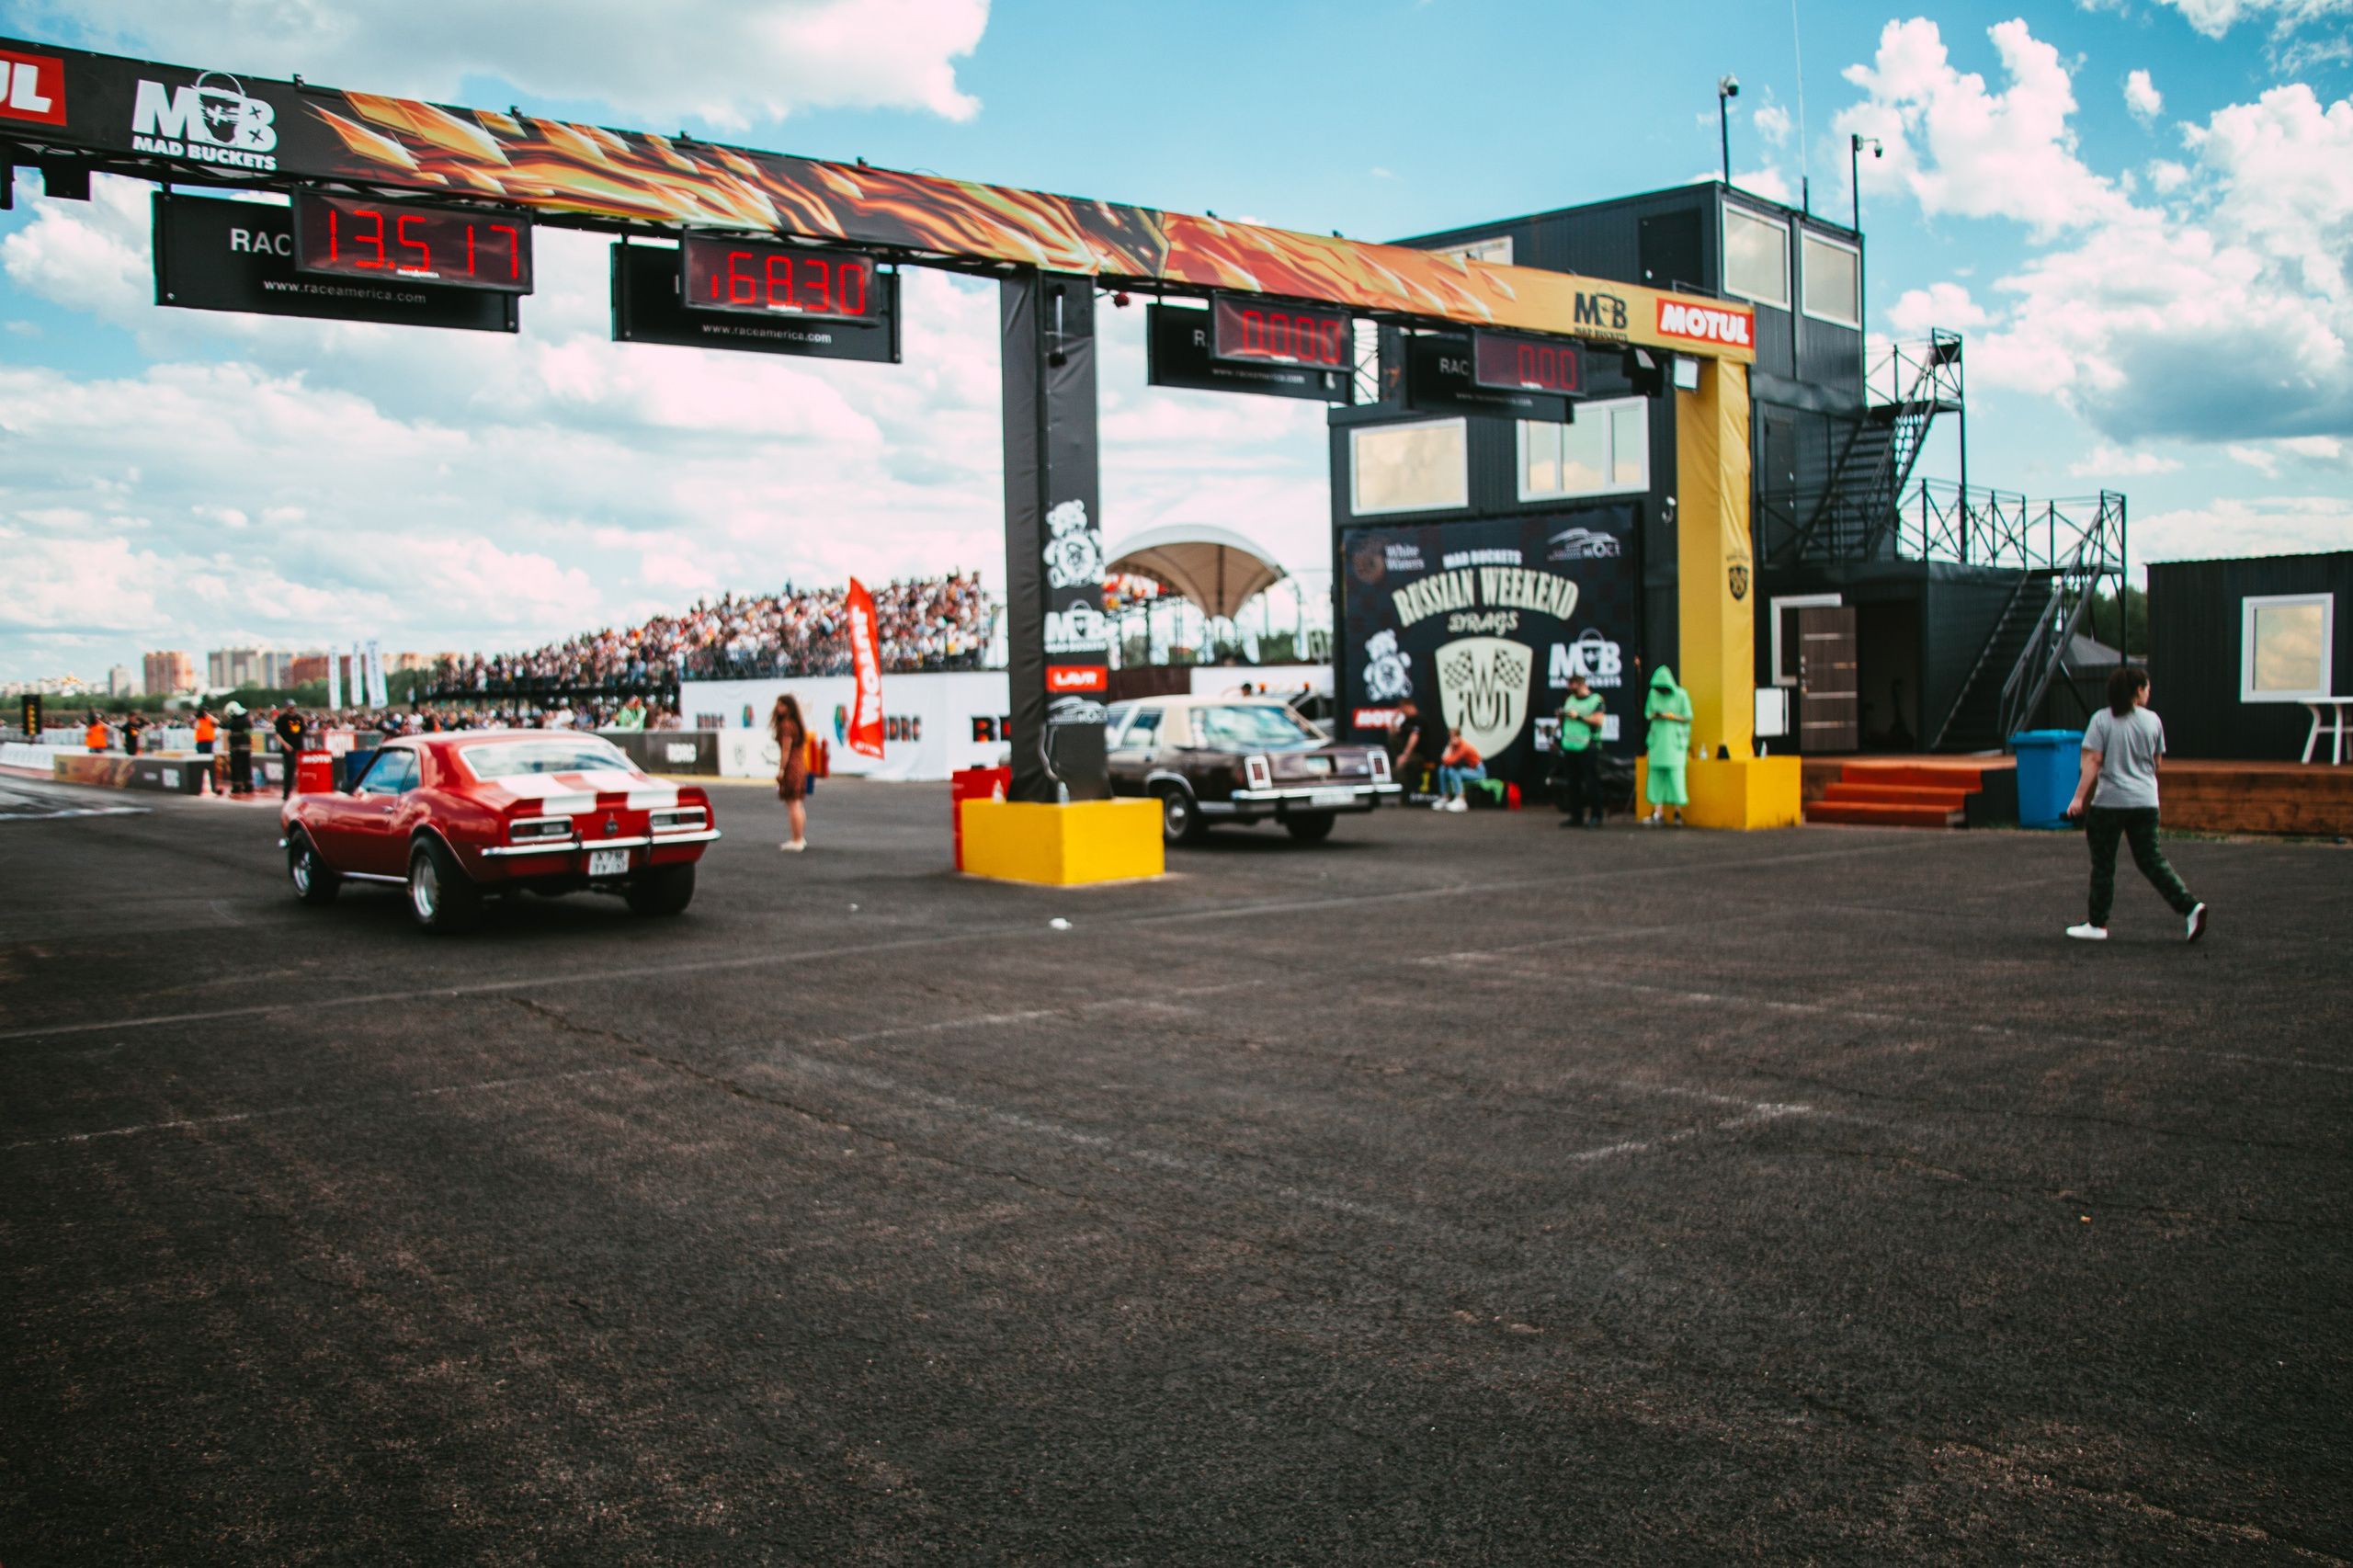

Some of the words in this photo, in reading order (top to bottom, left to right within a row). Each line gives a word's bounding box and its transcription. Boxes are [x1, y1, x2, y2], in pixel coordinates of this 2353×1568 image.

[132, 135, 185, 157] MAD
[187, 144, 278, 171] BUCKETS
[263, 279, 426, 304] www.raceamerica.com
[701, 323, 833, 345] www.raceamerica.com
[1659, 303, 1750, 345] MOTUL
[1384, 542, 1420, 558] White
[1392, 568, 1475, 628] RUSSIAN
[1480, 566, 1579, 620] WEEKEND
[1447, 609, 1519, 637] DRAGS
